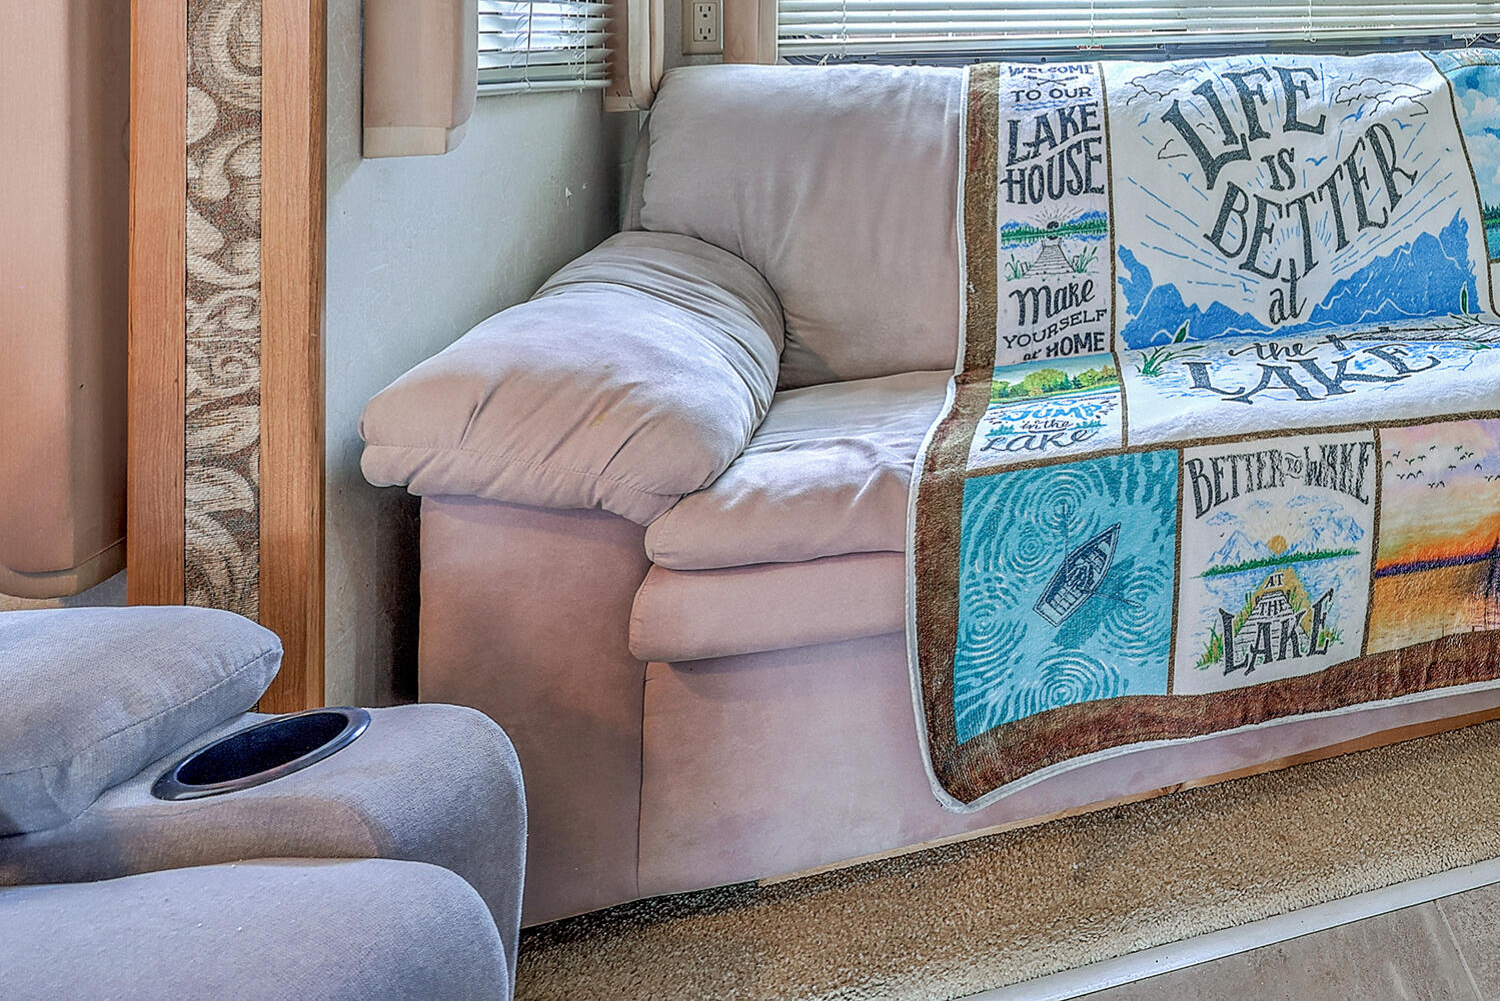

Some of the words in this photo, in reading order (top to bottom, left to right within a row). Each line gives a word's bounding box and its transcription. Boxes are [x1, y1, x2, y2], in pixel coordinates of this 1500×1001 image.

[1008, 64, 1094, 77] WELCOME
[1010, 89, 1042, 103] TO
[1049, 86, 1092, 100] OUR
[1005, 100, 1101, 167] LAKE
[1161, 65, 1327, 191] LIFE
[1000, 136, 1105, 205] HOUSE
[1260, 147, 1297, 192] IS
[1203, 122, 1419, 280] BETTER
[1268, 258, 1308, 326] at
[1003, 309, 1108, 349] YOURSELF
[1023, 349, 1043, 361] at
[1045, 331, 1105, 358] HOME
[1228, 341, 1320, 361] the
[1181, 342, 1442, 404] LAKE
[1002, 404, 1103, 421] JUMP
[1184, 448, 1286, 519] BETTER
[1285, 457, 1303, 474] TO
[1263, 572, 1285, 589] AT
[1258, 600, 1288, 617] THE
[1218, 587, 1334, 677] LAKE
